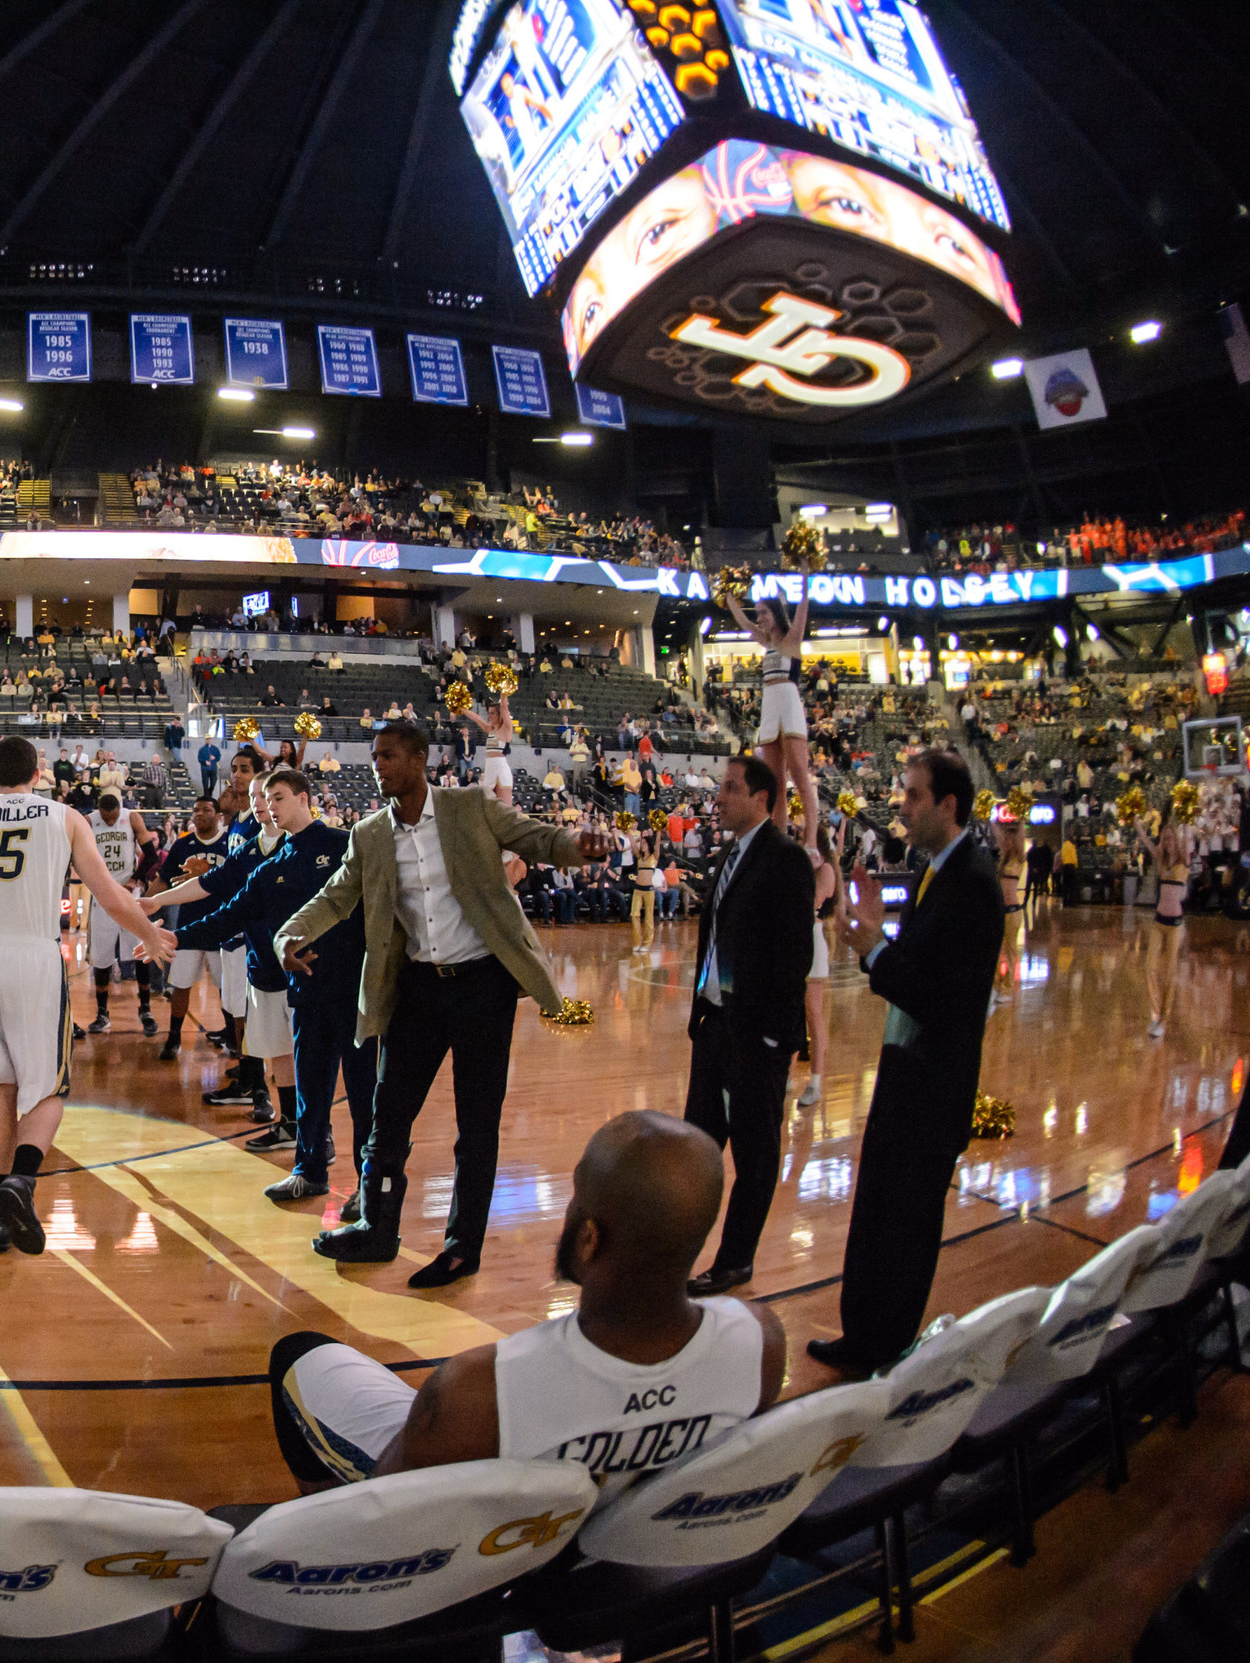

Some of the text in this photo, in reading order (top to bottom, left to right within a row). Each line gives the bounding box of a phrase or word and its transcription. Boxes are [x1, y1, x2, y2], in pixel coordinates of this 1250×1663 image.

[46, 335, 72, 347] 1985
[152, 337, 172, 346] 1985
[152, 348, 172, 357] 1990
[243, 342, 269, 354] 1938
[46, 350, 73, 362] 1996
[152, 358, 172, 368] 1993
[48, 368, 72, 376] ACC
[152, 370, 176, 378] ACC
[656, 566, 1034, 608] KAMEON HOLSEY
[96, 831, 128, 843] GEORGIA
[104, 845, 121, 858] 24
[107, 861, 125, 872] ECH
[623, 1384, 677, 1415] ACC
[248, 1548, 457, 1587] Aaron's
[286, 1578, 412, 1597] Aarons.com
